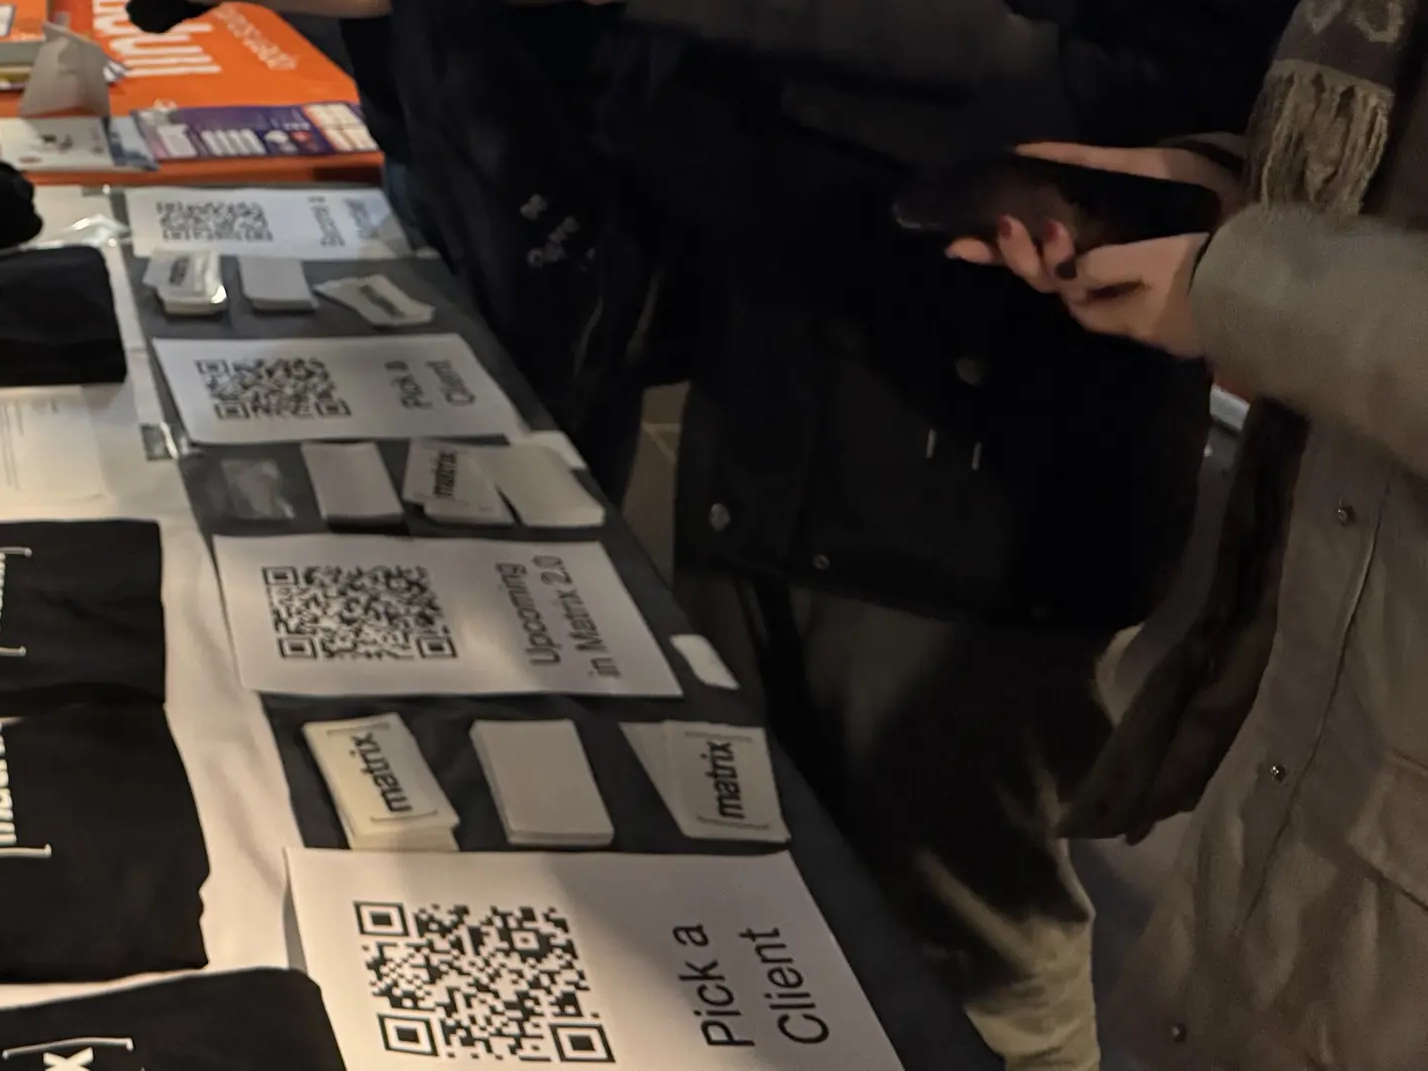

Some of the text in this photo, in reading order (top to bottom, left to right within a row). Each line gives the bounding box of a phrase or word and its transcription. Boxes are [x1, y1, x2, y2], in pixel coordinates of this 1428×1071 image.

[494, 561, 563, 666] Upcoming
[531, 554, 622, 677] in Matrix 2.0
[673, 924, 756, 1048] Pick a
[738, 926, 830, 1045] Client
